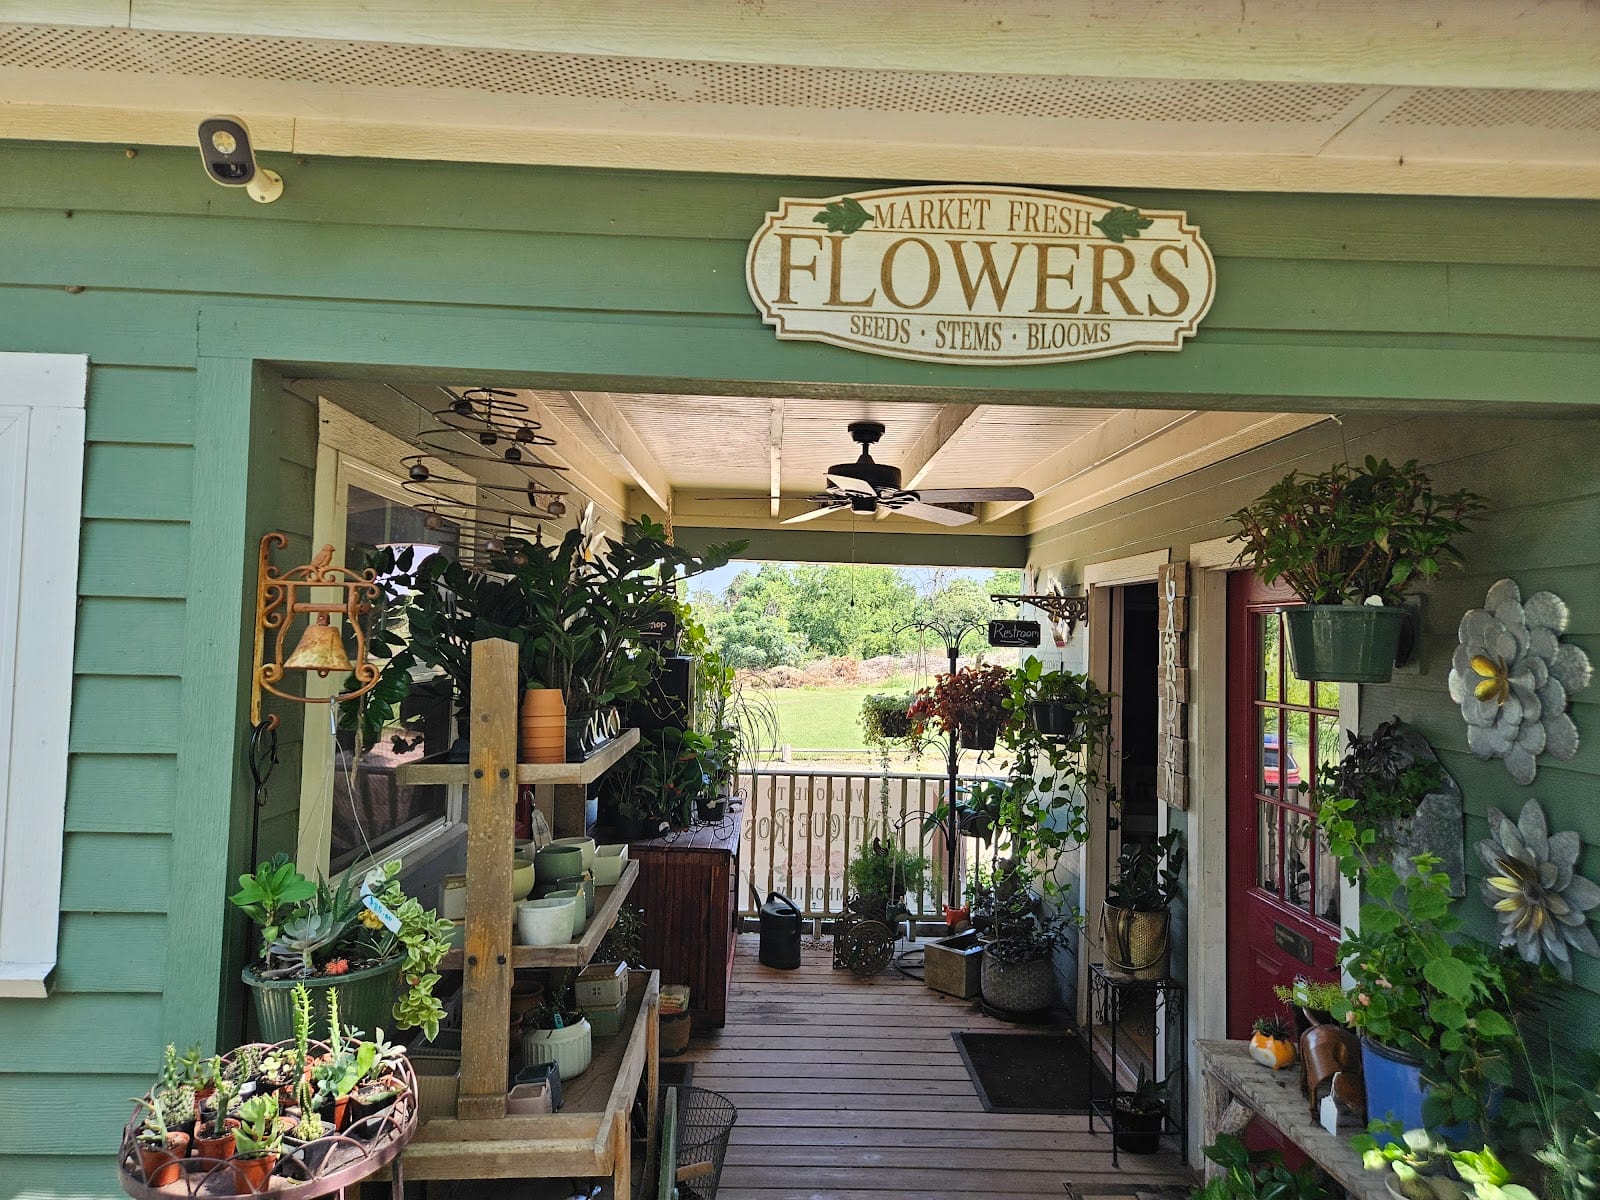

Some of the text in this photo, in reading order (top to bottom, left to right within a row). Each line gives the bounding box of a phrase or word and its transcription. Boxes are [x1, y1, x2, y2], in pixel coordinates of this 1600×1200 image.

[872, 198, 1093, 236] MARKET FRESH
[771, 232, 1191, 318] FLOWERS
[850, 314, 1111, 352] SEEDS STEMS BLOOMS
[993, 622, 1039, 639] Restroom
[1165, 563, 1177, 804] GARDEN
